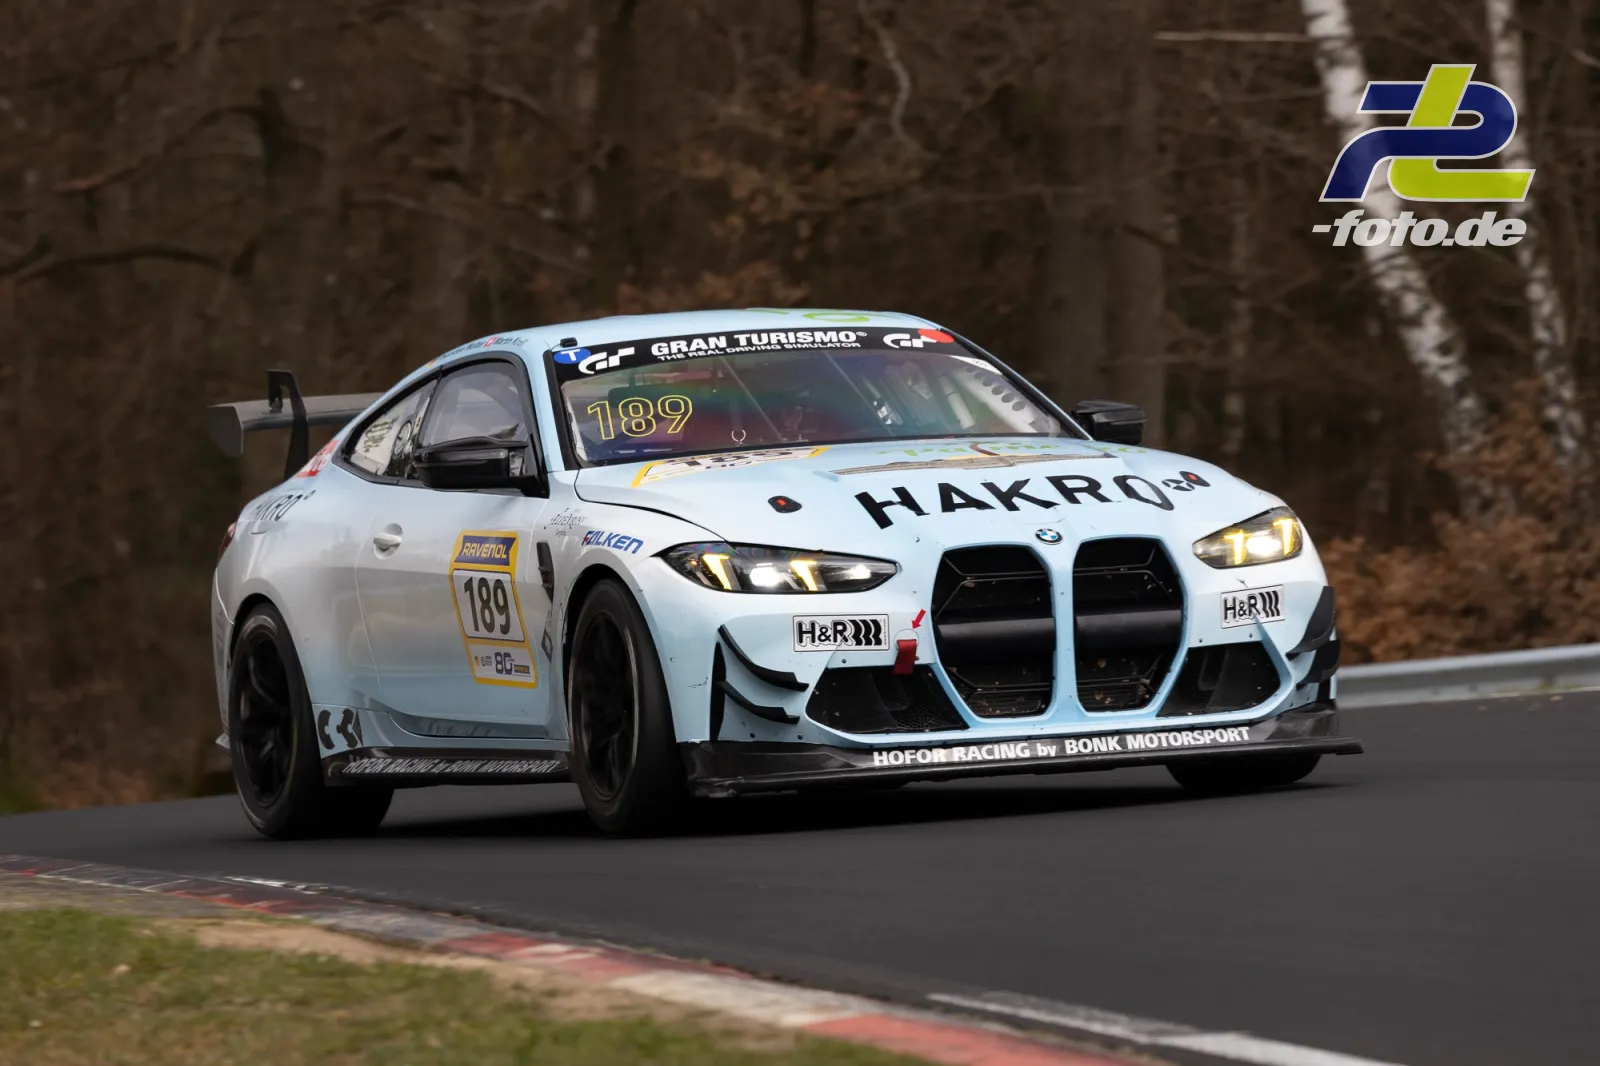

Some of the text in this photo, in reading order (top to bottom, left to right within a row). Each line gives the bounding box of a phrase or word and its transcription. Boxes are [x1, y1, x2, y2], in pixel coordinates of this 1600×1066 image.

[560, 349, 581, 361] T
[651, 335, 728, 356] GRAN
[657, 341, 862, 362] THE REAL DRIVING SIMULATOR
[587, 395, 693, 441] 189
[854, 474, 1175, 530] HAKRO
[461, 542, 508, 559] RAVENOL
[581, 530, 644, 554] FALKEN
[463, 576, 511, 635] 189
[1223, 595, 1261, 621] H&R
[797, 621, 850, 645] H&R
[873, 726, 1251, 766] HOFOR RACING by BONK MOTORSPORT
[383, 757, 441, 774] RACING
[443, 758, 489, 773] BONK
[477, 758, 562, 774] MOTORSPORT
